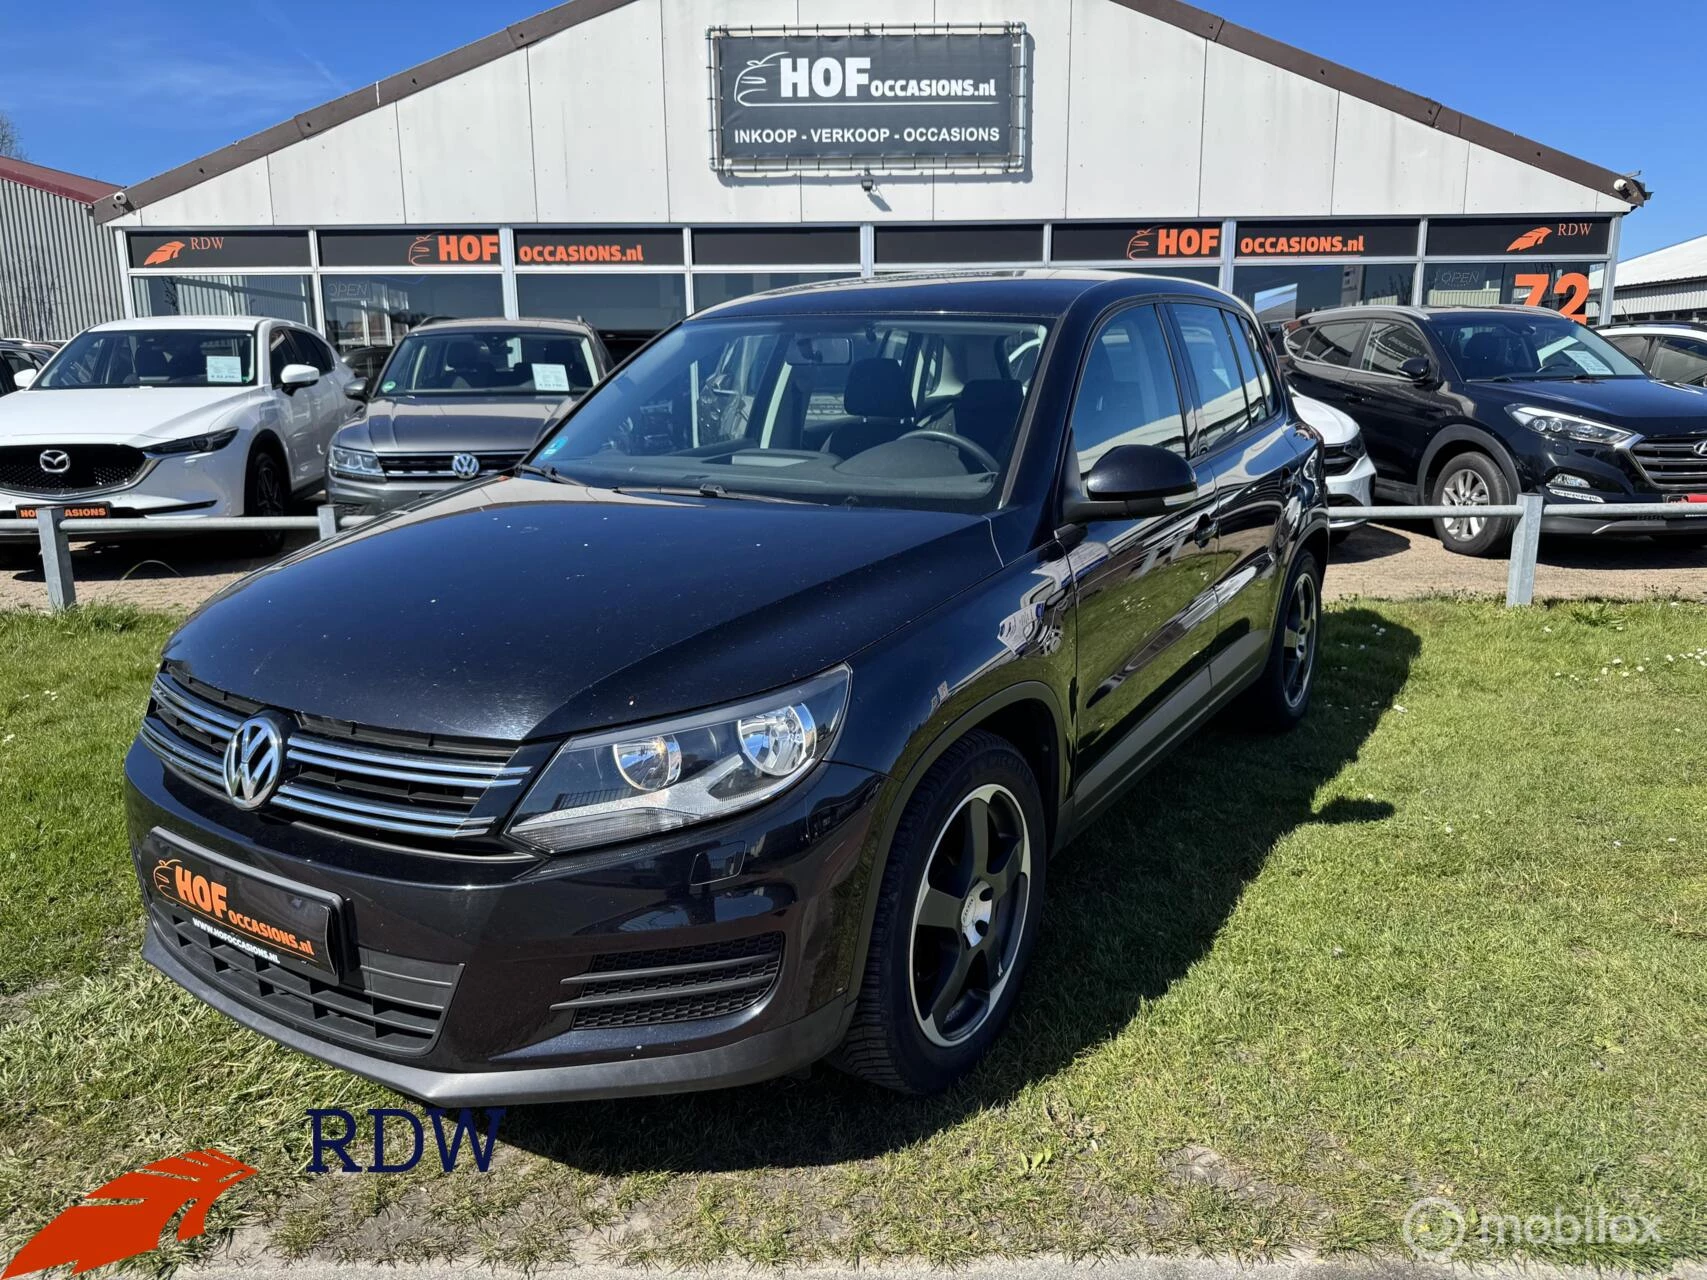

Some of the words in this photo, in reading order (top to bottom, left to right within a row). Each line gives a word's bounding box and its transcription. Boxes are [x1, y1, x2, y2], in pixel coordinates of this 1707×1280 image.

[780, 57, 871, 98] HOF
[870, 78, 996, 97] OCCASIONS.nl
[734, 129, 798, 144] INKOOP
[810, 128, 891, 143] VERKOOP
[903, 127, 1000, 143] OCCASIONS
[1557, 223, 1593, 237] RDW
[190, 237, 225, 251] RDW
[437, 234, 500, 263] HOF
[518, 244, 645, 264] OCCASIONS.nl
[1156, 228, 1220, 255] HOF
[1240, 235, 1365, 255] OCCASIONS.nl
[1441, 271, 1480, 283] OPEN
[327, 283, 368, 297] OPEN
[1514, 272, 1590, 325] 72
[20, 508, 38, 518] HO
[175, 865, 227, 918] HOF
[228, 909, 315, 956] OCCASIONS.nl
[192, 917, 281, 964] WWW.HOFOCCASIONS.NL
